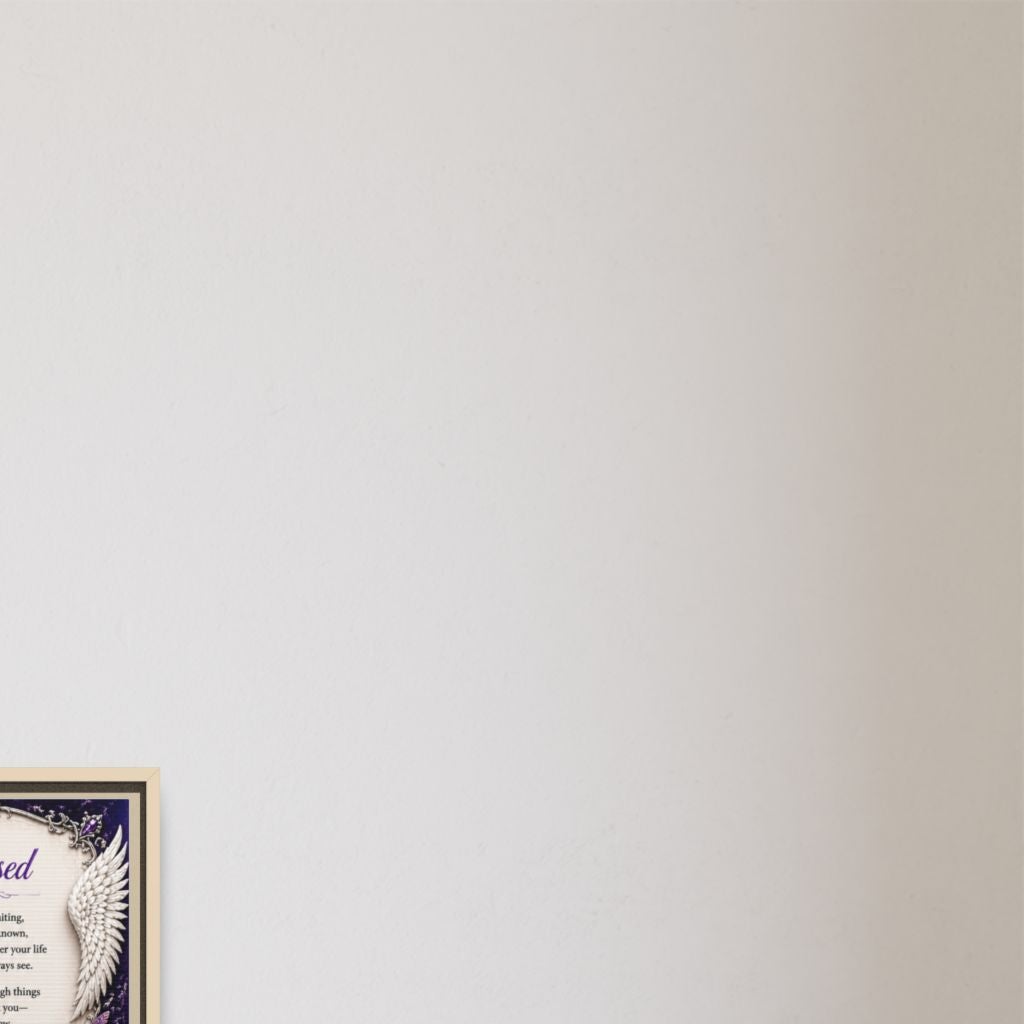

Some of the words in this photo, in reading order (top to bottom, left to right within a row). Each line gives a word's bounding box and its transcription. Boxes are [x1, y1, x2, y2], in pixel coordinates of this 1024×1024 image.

[10, 946, 31, 957] your
[33, 943, 48, 954] life
[16, 962, 33, 970] see.
[13, 986, 41, 999] things
